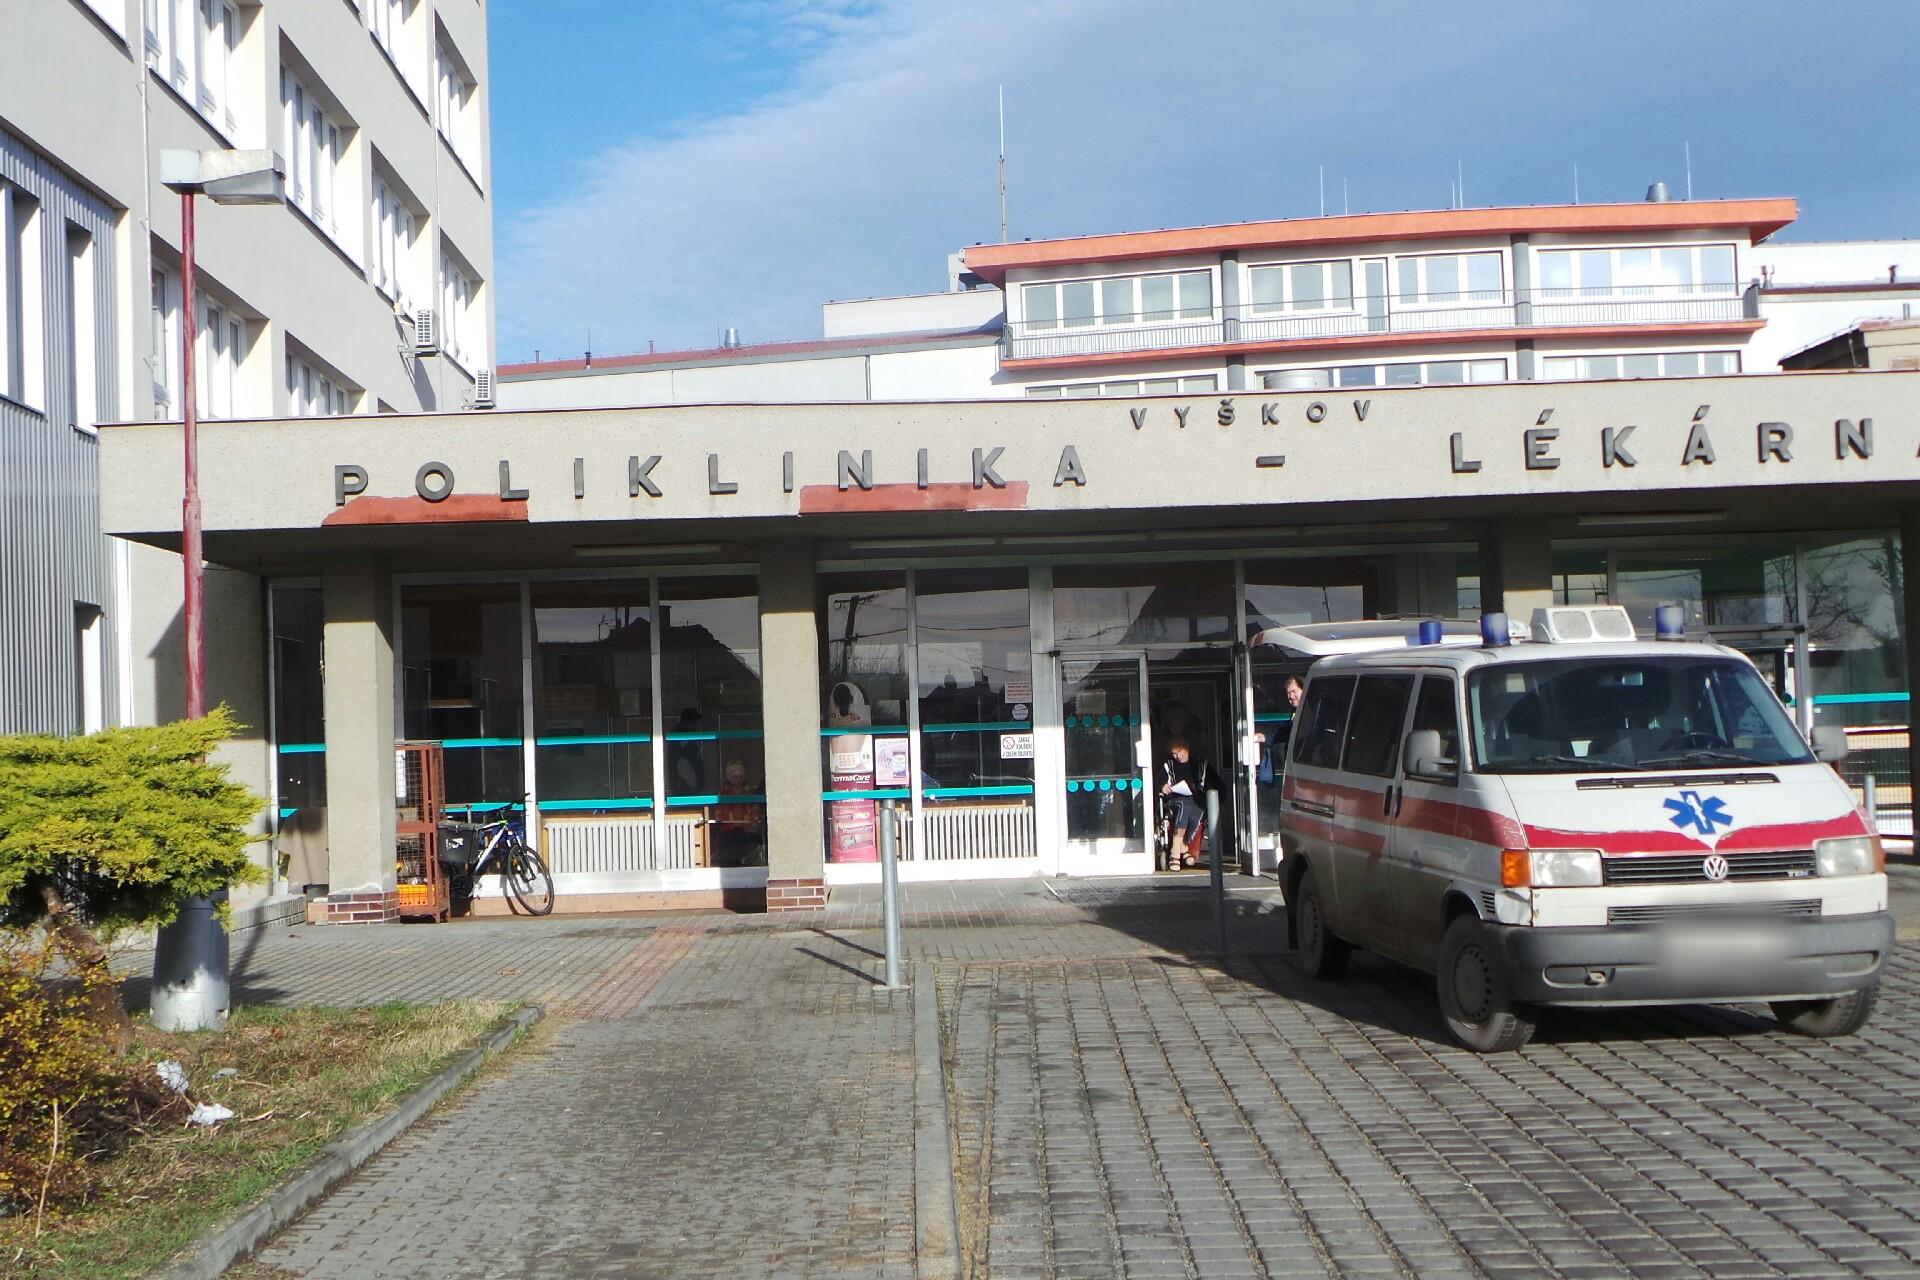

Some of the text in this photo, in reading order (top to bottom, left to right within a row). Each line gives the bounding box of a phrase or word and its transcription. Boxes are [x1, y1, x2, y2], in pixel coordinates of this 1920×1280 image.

[1130, 399, 1371, 429] VYŠKOV
[335, 445, 1086, 505] POLIKLINIKA
[1450, 405, 1920, 474] LÉKÁRN
[1703, 855, 1728, 881] VW
